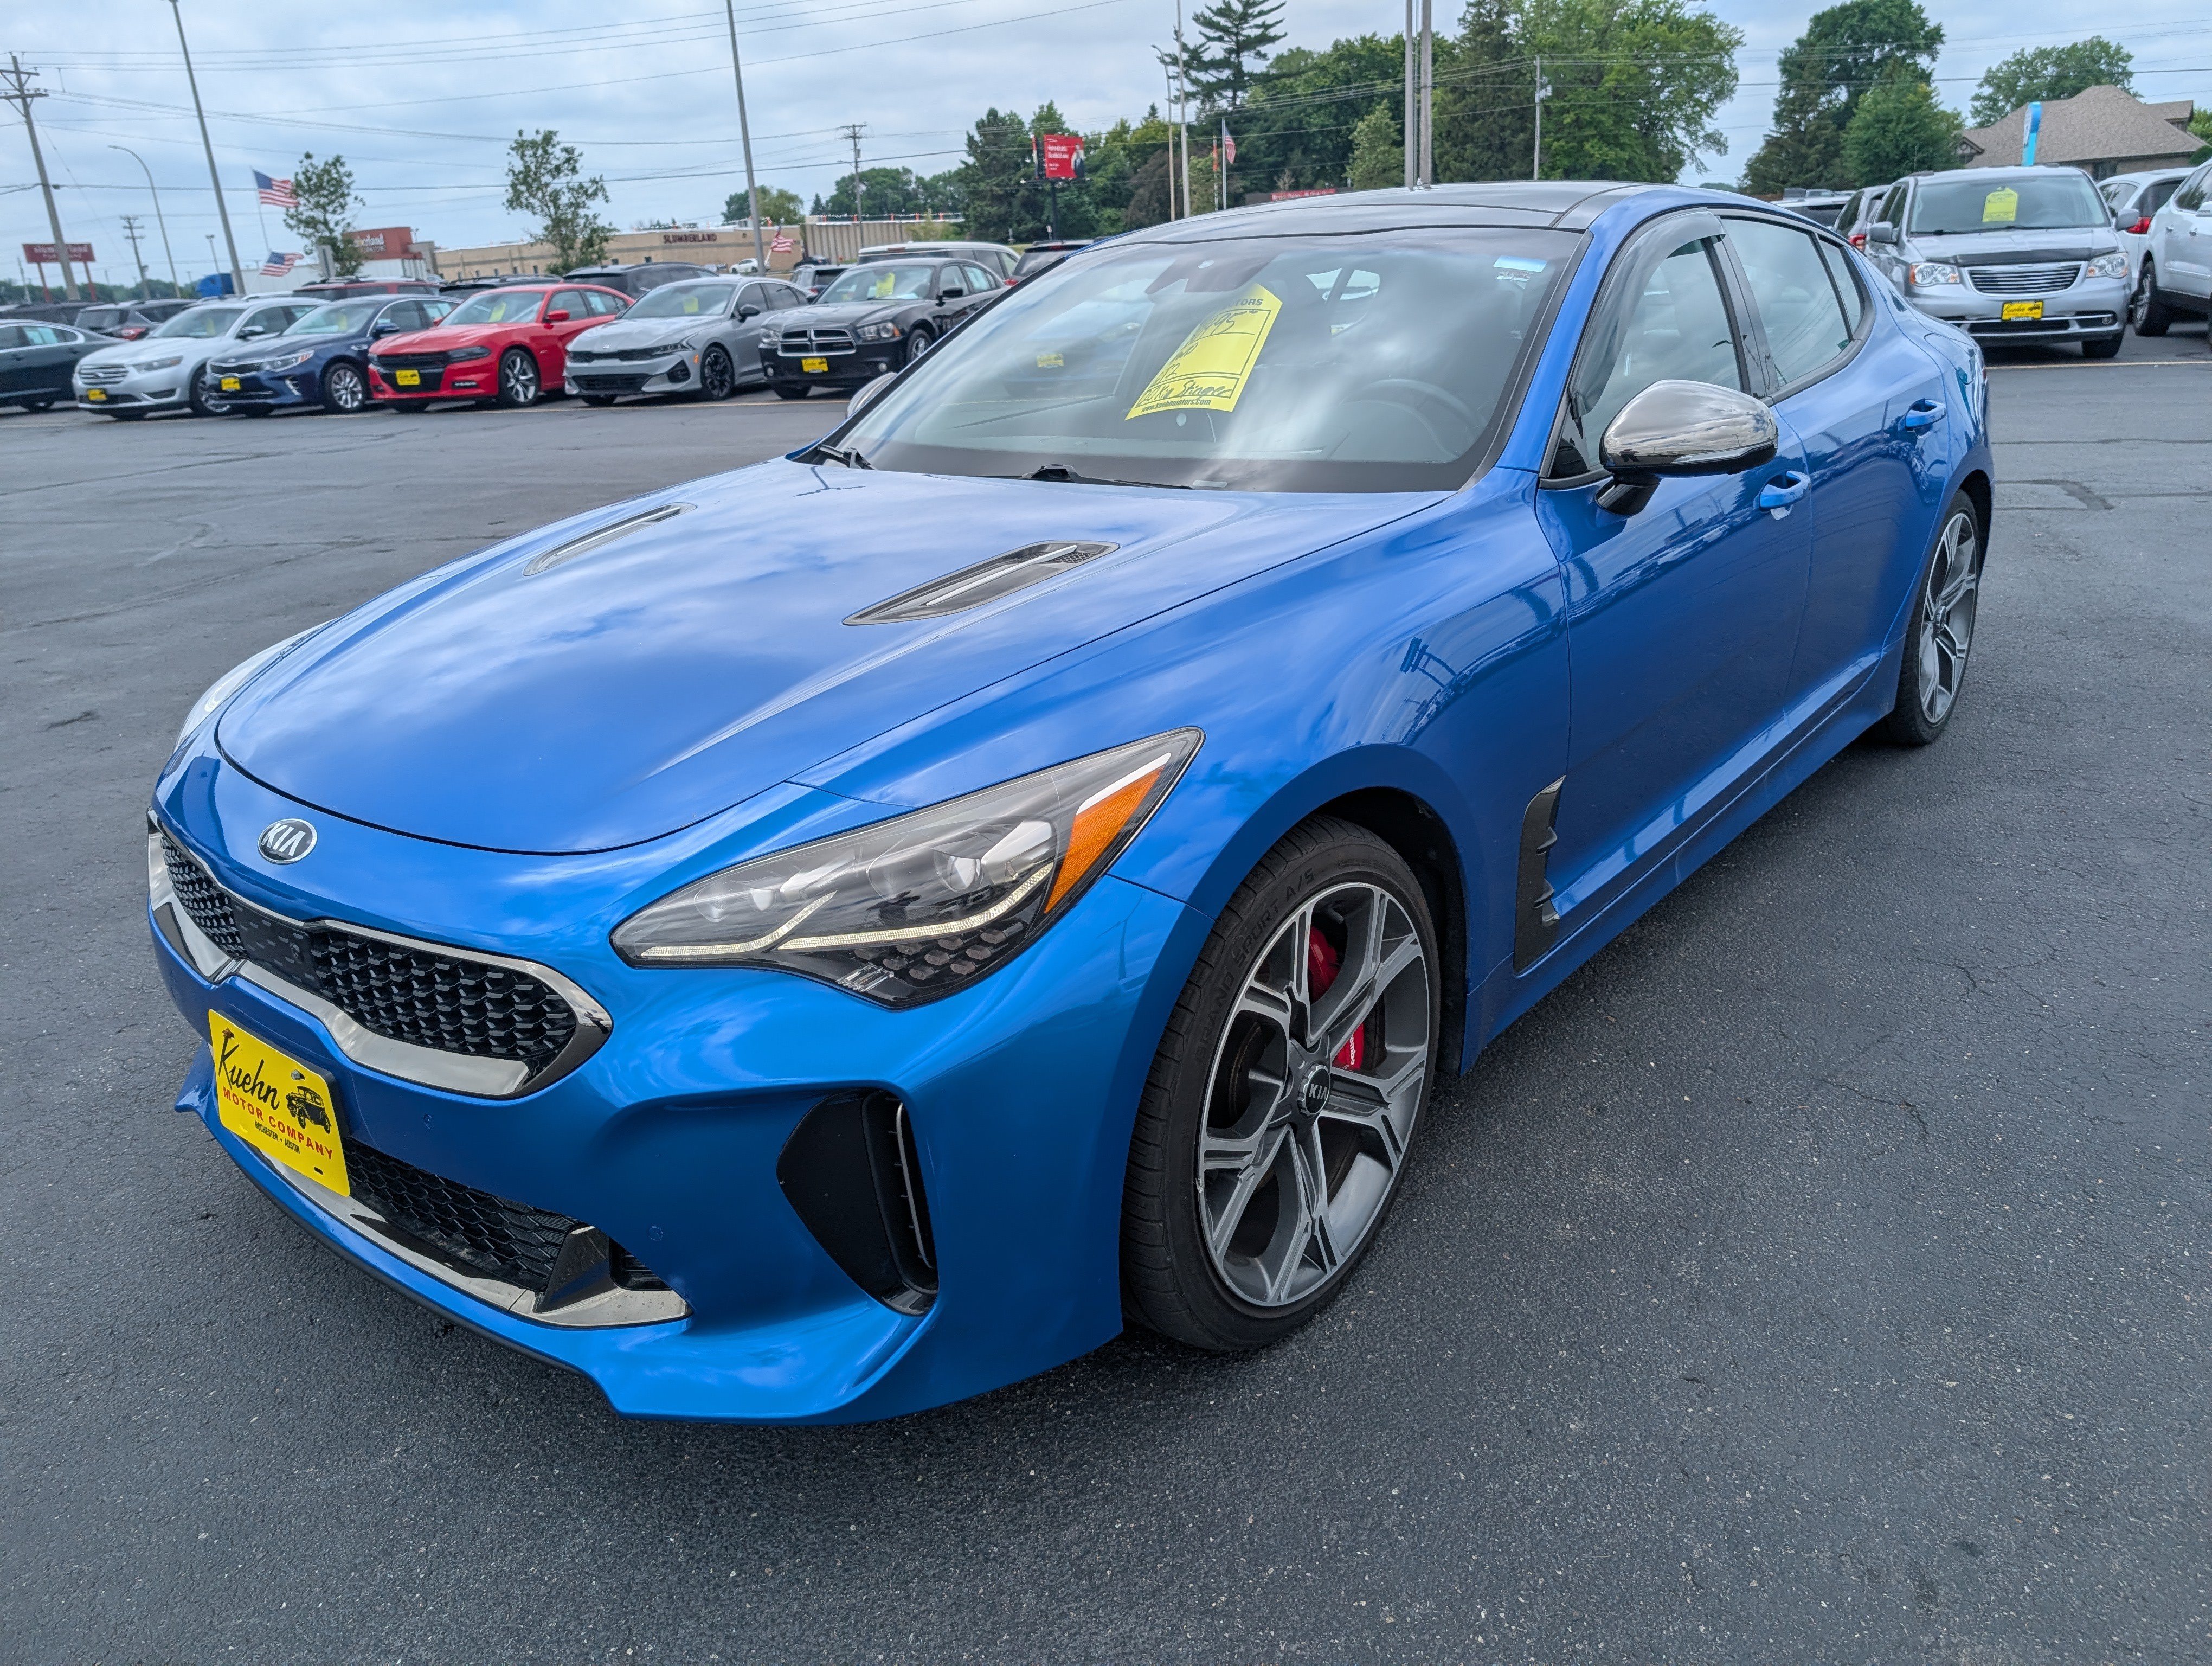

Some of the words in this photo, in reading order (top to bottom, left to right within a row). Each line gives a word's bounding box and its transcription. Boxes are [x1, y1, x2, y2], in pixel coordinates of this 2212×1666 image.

[663, 233, 717, 244] SLUMBERLAND
[1141, 399, 1211, 412] www.kuehnmotors.com
[261, 823, 306, 856] KIA
[1231, 896, 1279, 969] SPORT
[1285, 869, 1315, 901] A/S
[218, 1035, 280, 1110] Kuehn
[1308, 1083, 1327, 1100] KIA
[222, 1086, 264, 1122] MOTOR
[268, 1115, 333, 1160] COMPANY
[254, 1120, 279, 1142] ROCHESTER
[284, 1138, 300, 1155] AUSTIN
